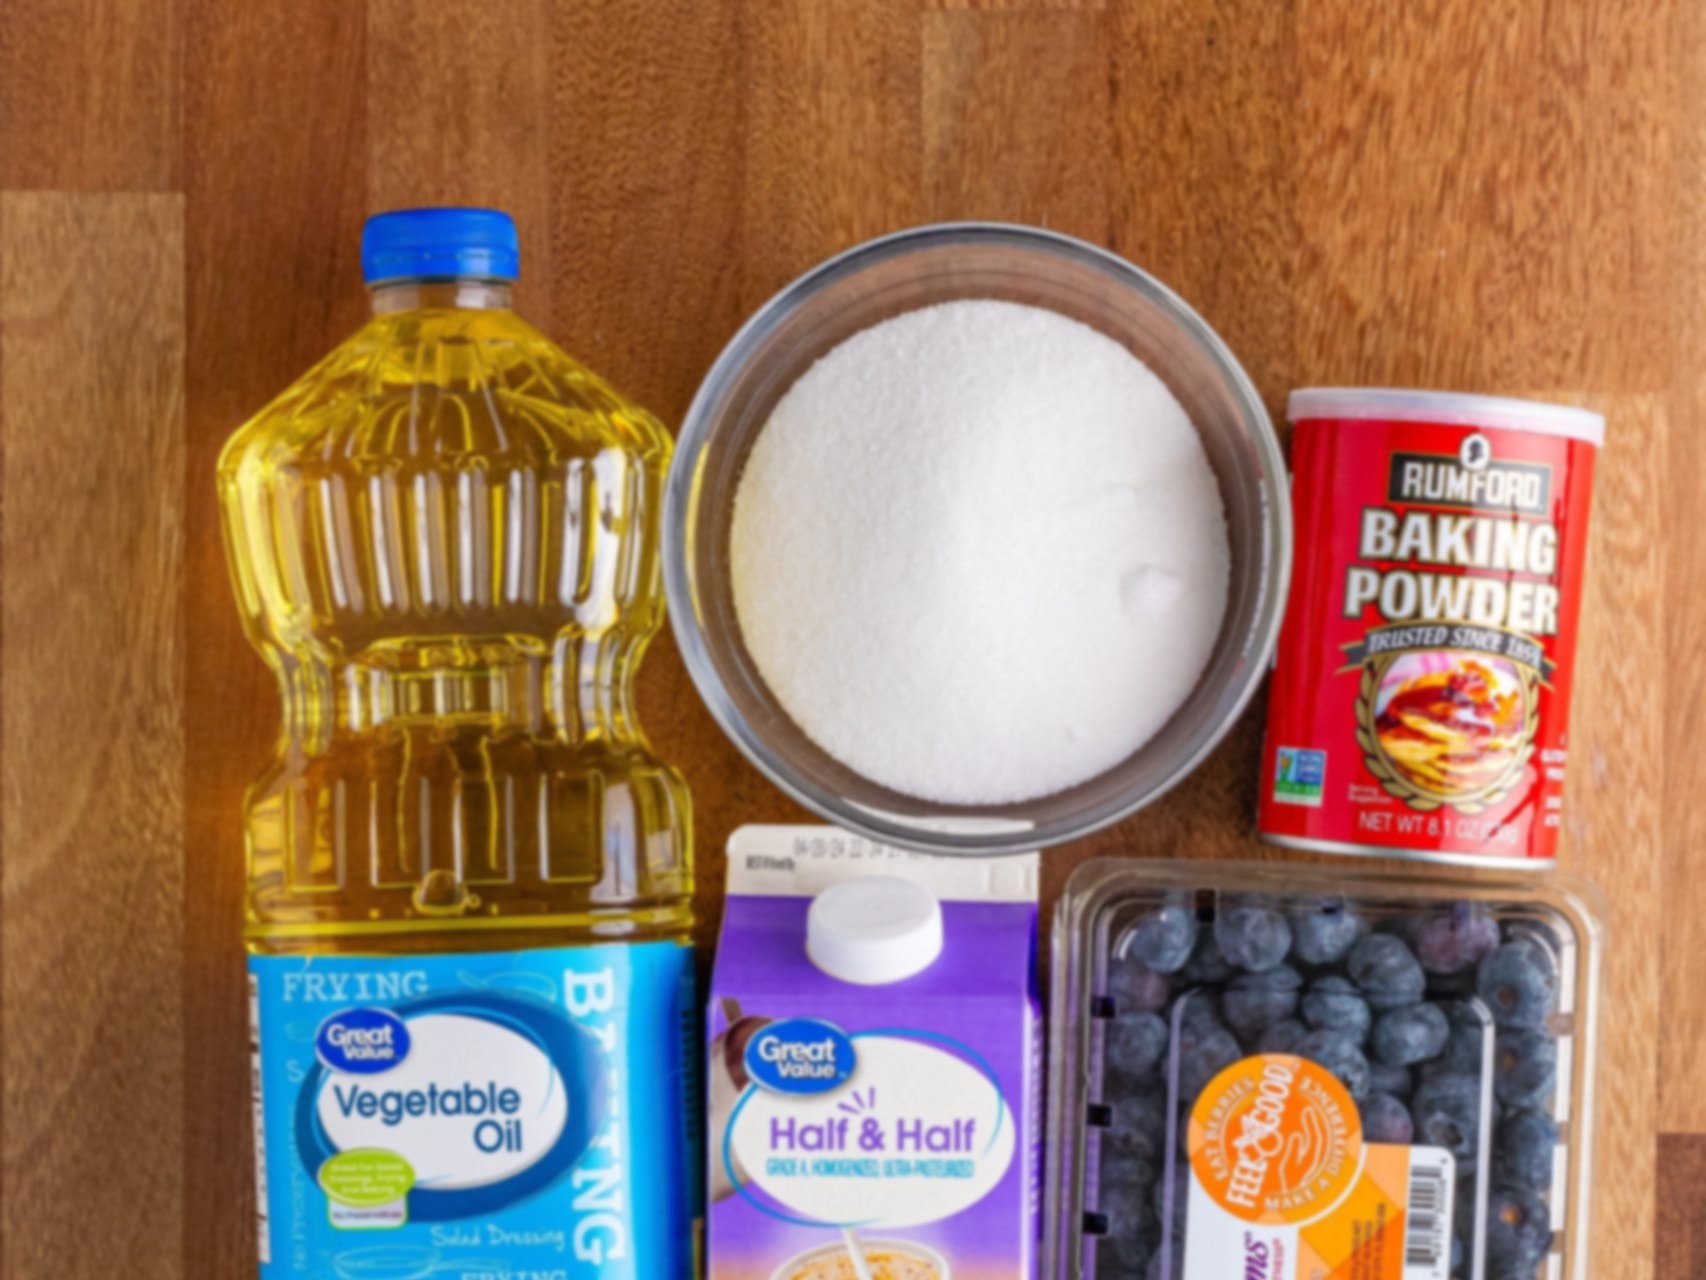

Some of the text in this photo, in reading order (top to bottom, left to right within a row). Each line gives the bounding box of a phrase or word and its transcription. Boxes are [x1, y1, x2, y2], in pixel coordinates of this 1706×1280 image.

[1402, 461, 1541, 507] RUMFORD
[1360, 508, 1558, 575] BAKING
[1343, 566, 1559, 634] POWDER
[1368, 626, 1447, 653] TRUSTED
[1450, 627, 1501, 650] SINCE
[1359, 811, 1392, 832] NET
[1396, 814, 1424, 835] WT
[1428, 817, 1451, 838] 8.1
[283, 970, 429, 1001] FRYING
[327, 1022, 393, 1047] Great
[758, 1036, 836, 1063] Great
[342, 1045, 395, 1060] Value
[777, 1060, 835, 1079] Value
[333, 1081, 522, 1126] Vegetable
[1203, 1075, 1255, 1141] BERRIES
[1250, 1063, 1295, 1135] GOOD
[473, 1119, 523, 1154] Oil
[769, 1117, 976, 1152] Half & Half
[1263, 1075, 1349, 1211] MAKE A DIFFERENCE
[1203, 1147, 1230, 1182] EAT
[1226, 1158, 1269, 1209] FEEL
[430, 1224, 566, 1252] Salad Dressing
